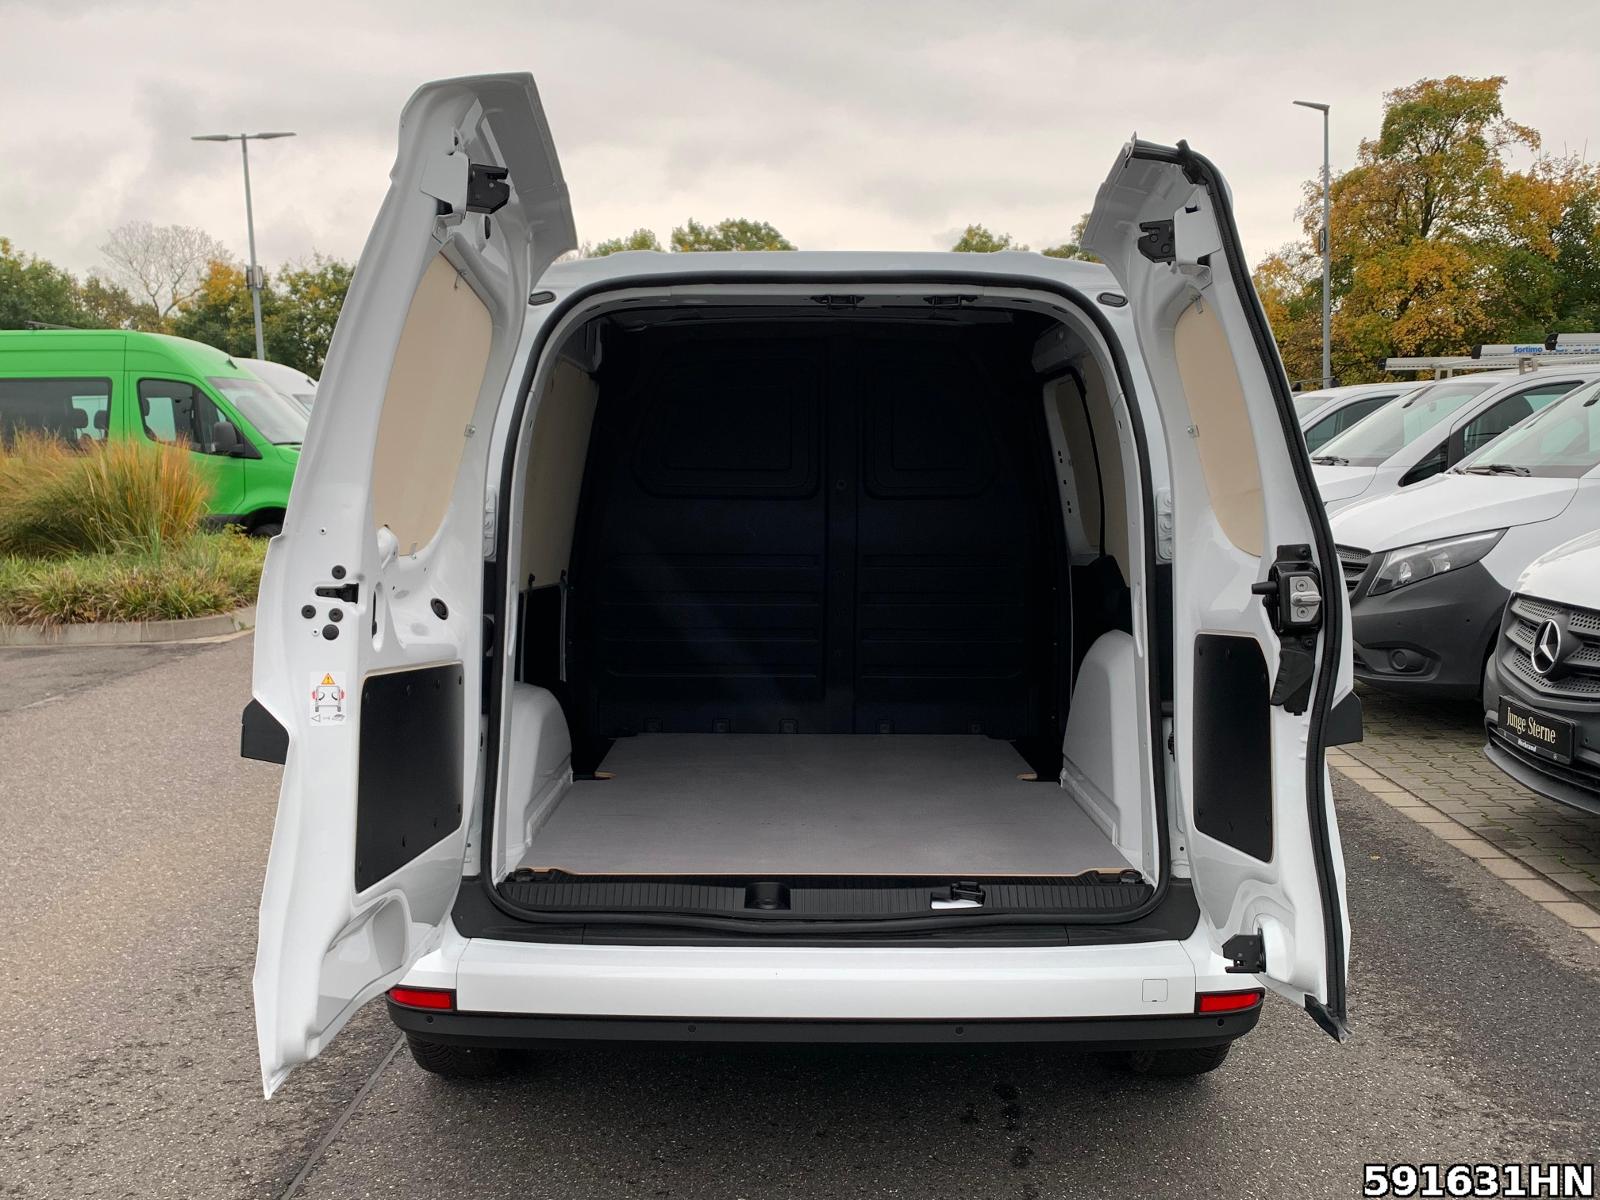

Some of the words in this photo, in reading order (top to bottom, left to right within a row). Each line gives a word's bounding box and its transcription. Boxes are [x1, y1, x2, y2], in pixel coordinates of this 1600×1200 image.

[1513, 345, 1543, 353] Sortimo
[1506, 706, 1527, 735] Junge
[1528, 716, 1556, 744] Sterne
